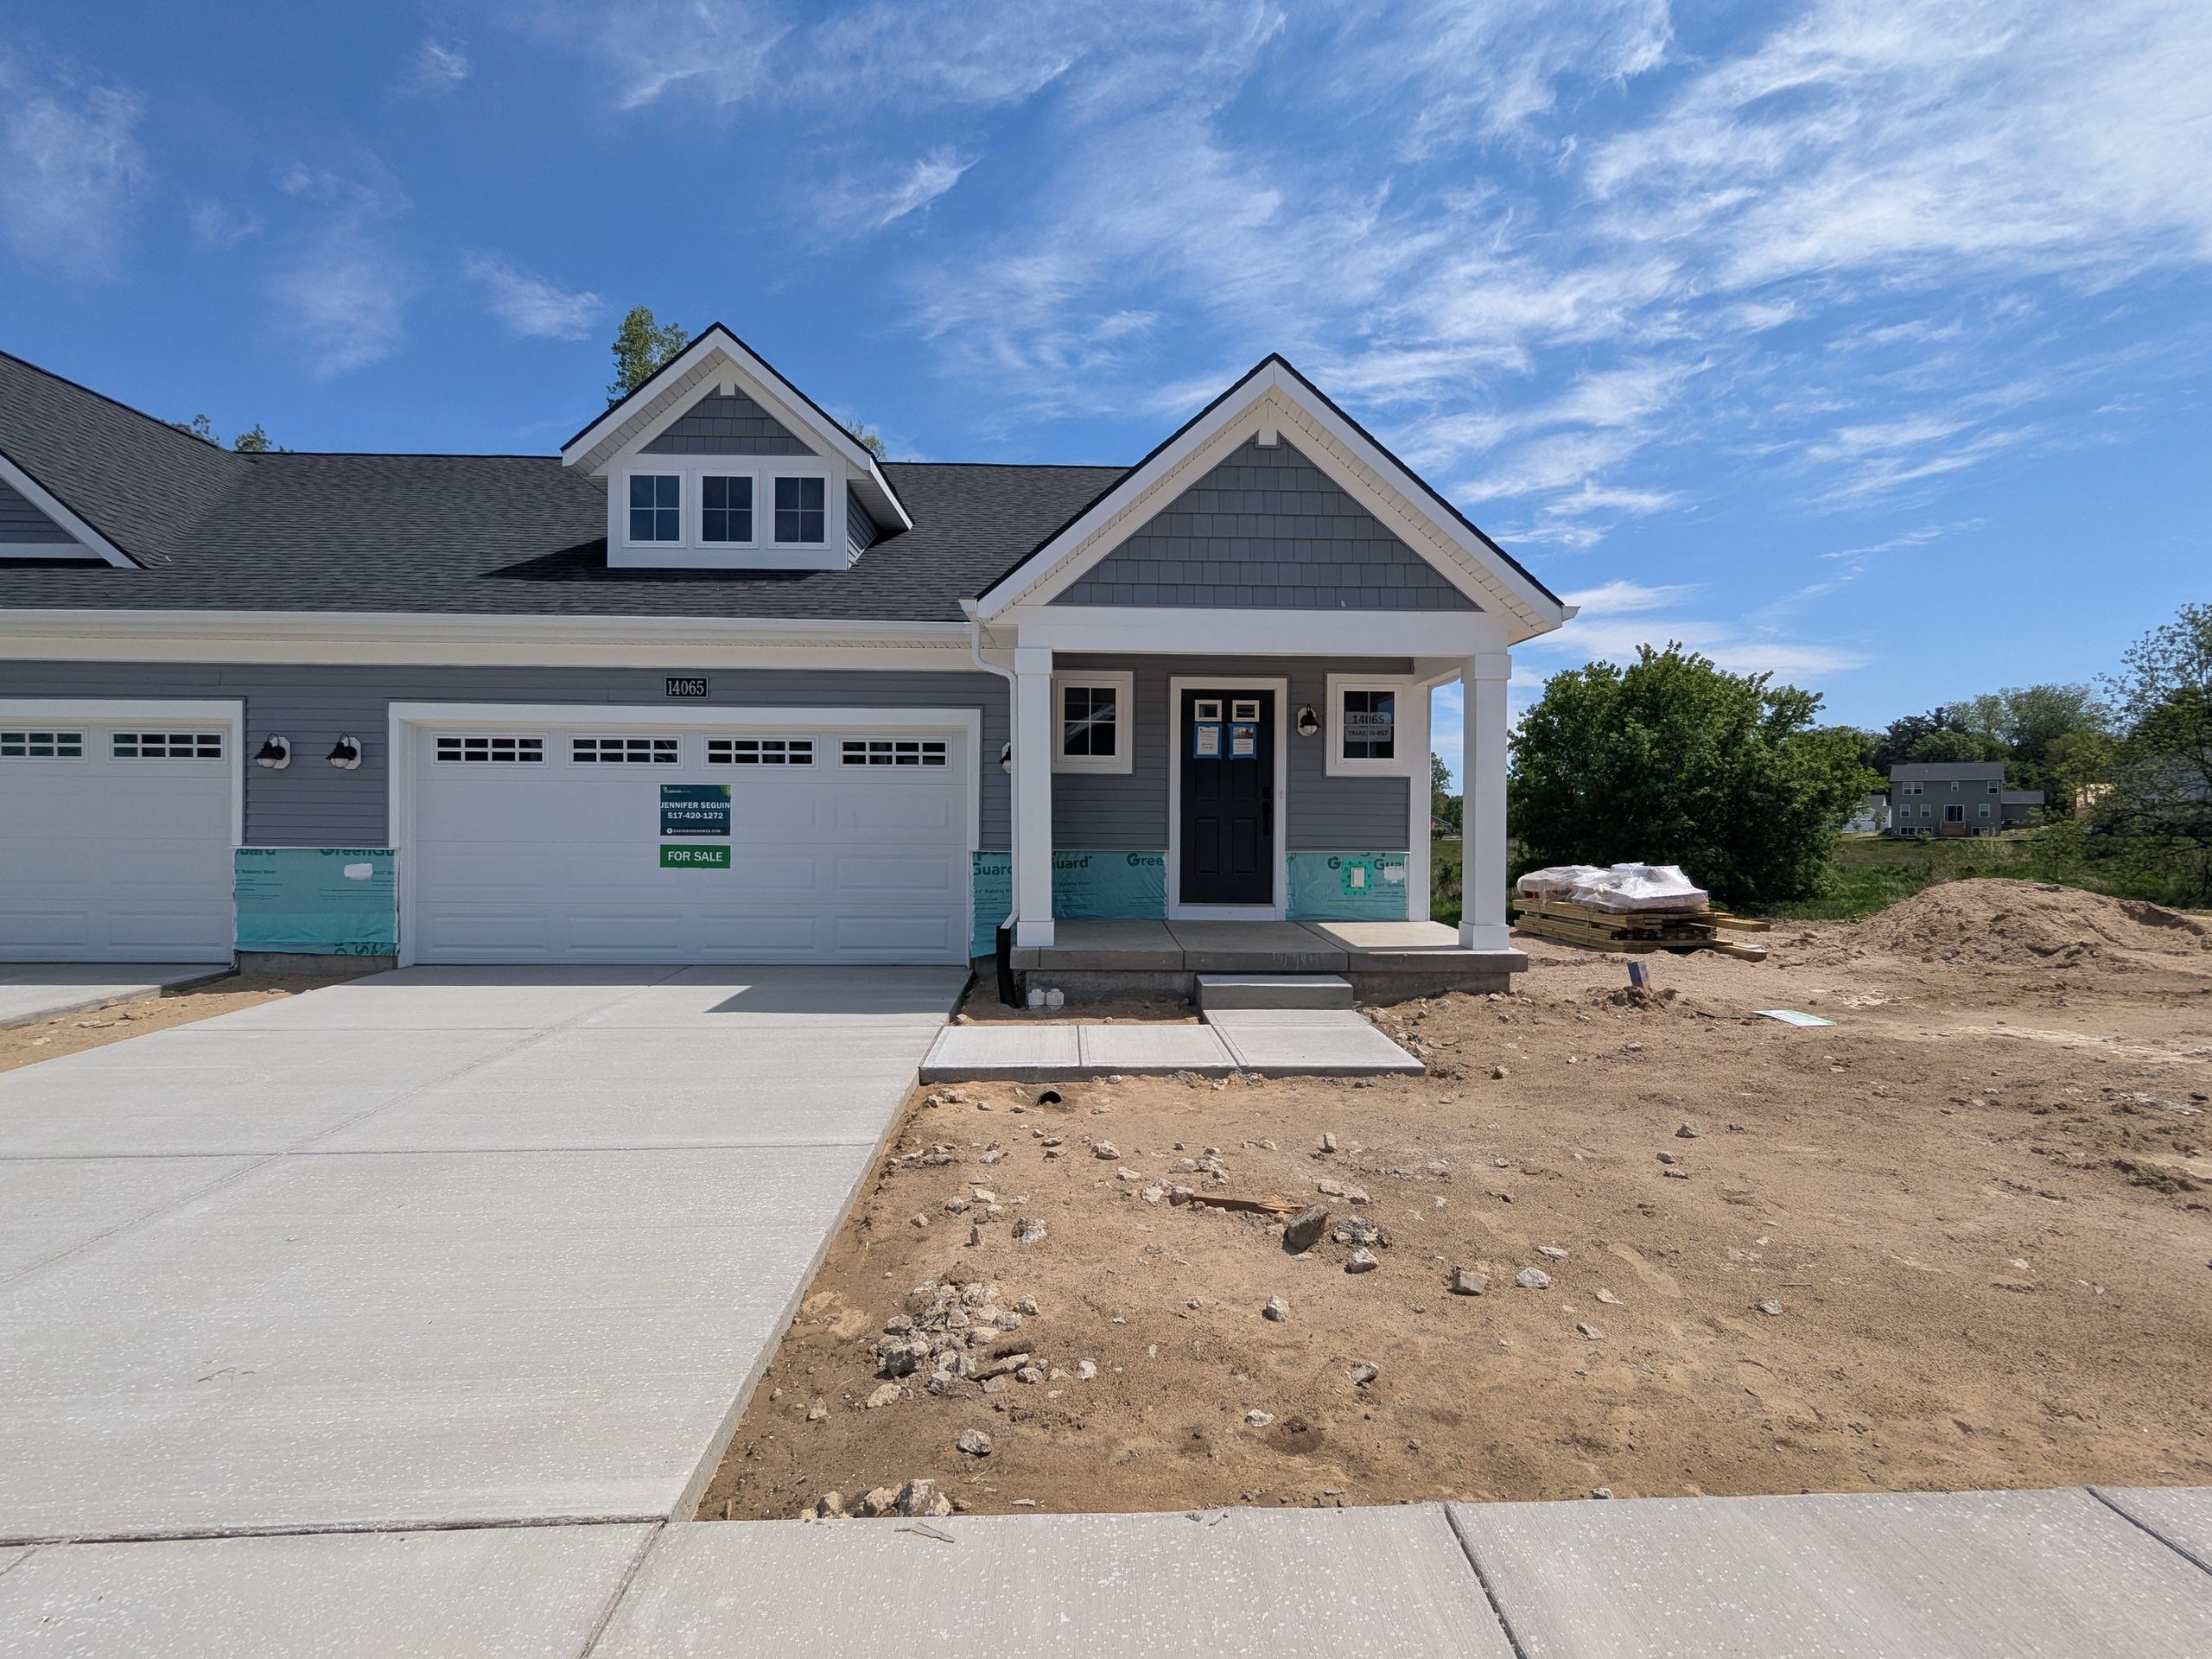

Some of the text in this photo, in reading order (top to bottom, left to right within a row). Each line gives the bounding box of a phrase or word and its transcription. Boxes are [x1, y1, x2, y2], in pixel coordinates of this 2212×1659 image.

[668, 680, 704, 695] 14065
[1352, 715, 1384, 724] 14065
[668, 851, 723, 861] FOR SALE
[1052, 855, 1089, 869] uard
[1127, 852, 1164, 867] Gree
